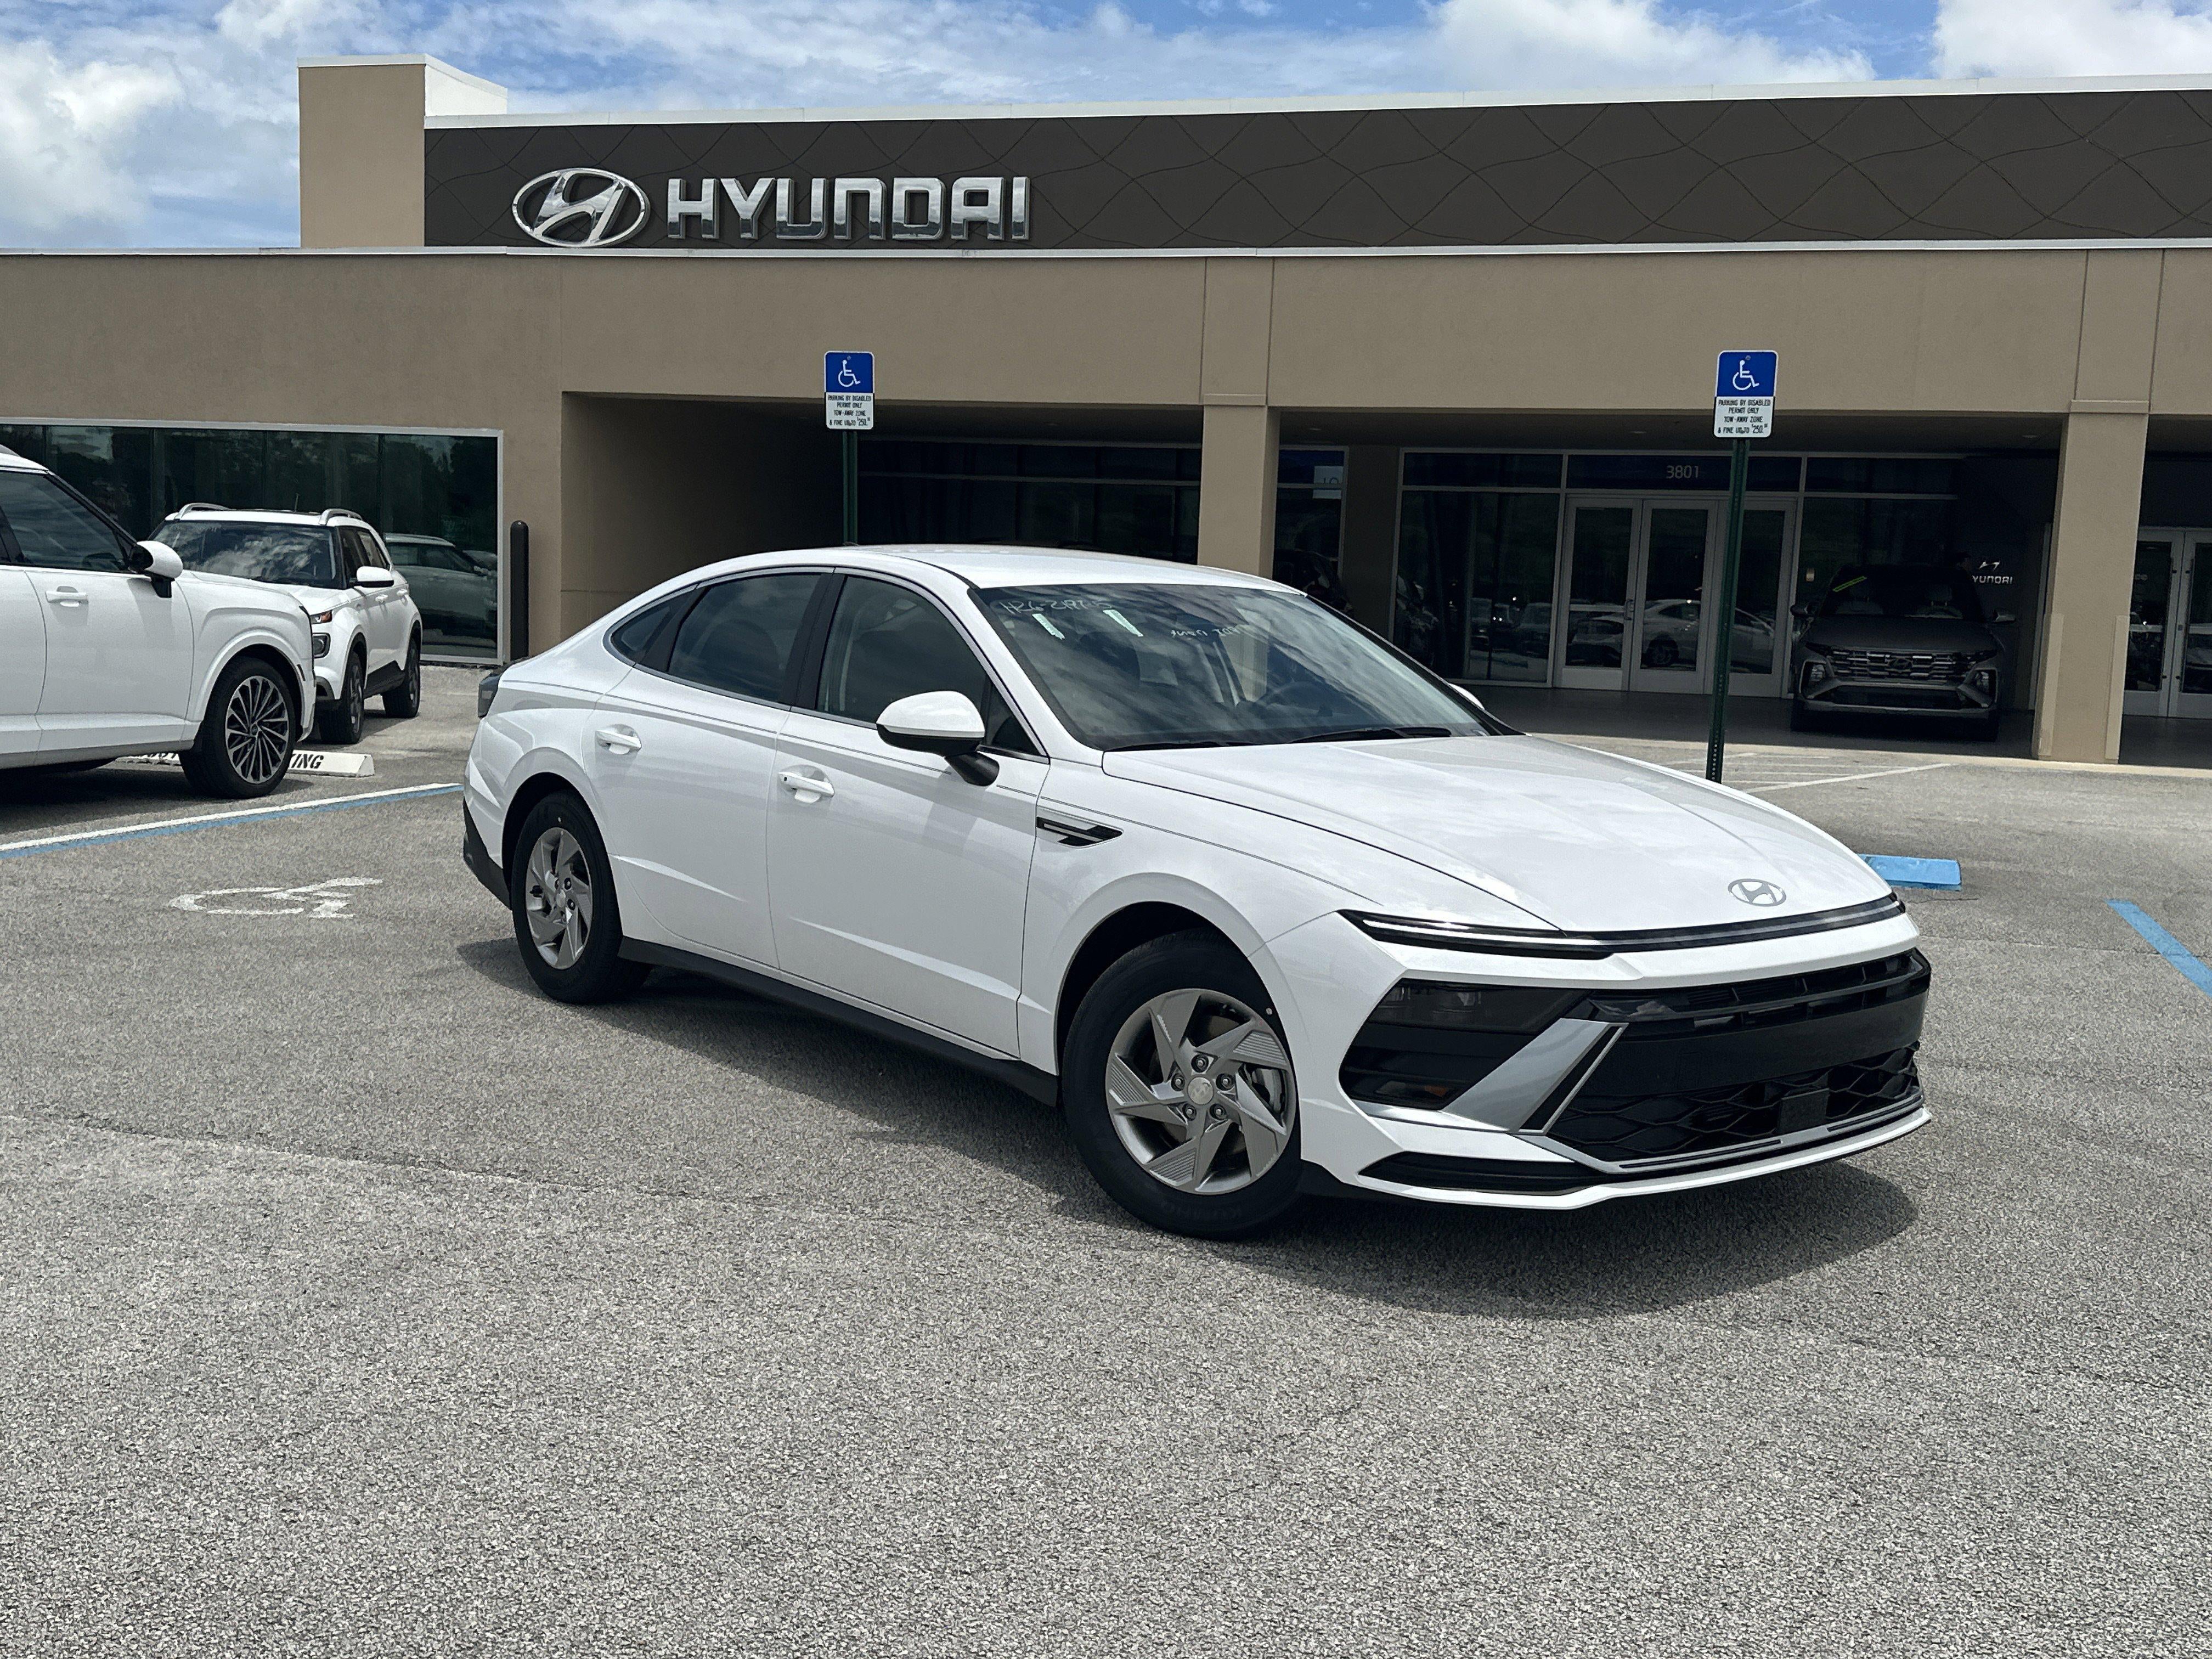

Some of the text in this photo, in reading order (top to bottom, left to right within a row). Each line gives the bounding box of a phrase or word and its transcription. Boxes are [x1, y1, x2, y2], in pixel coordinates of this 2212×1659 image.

[667, 176, 1030, 240] HYUNDAI
[1666, 465, 1699, 478] 3801
[1972, 575, 2014, 584] YUNDAI
[292, 754, 324, 769] ING
